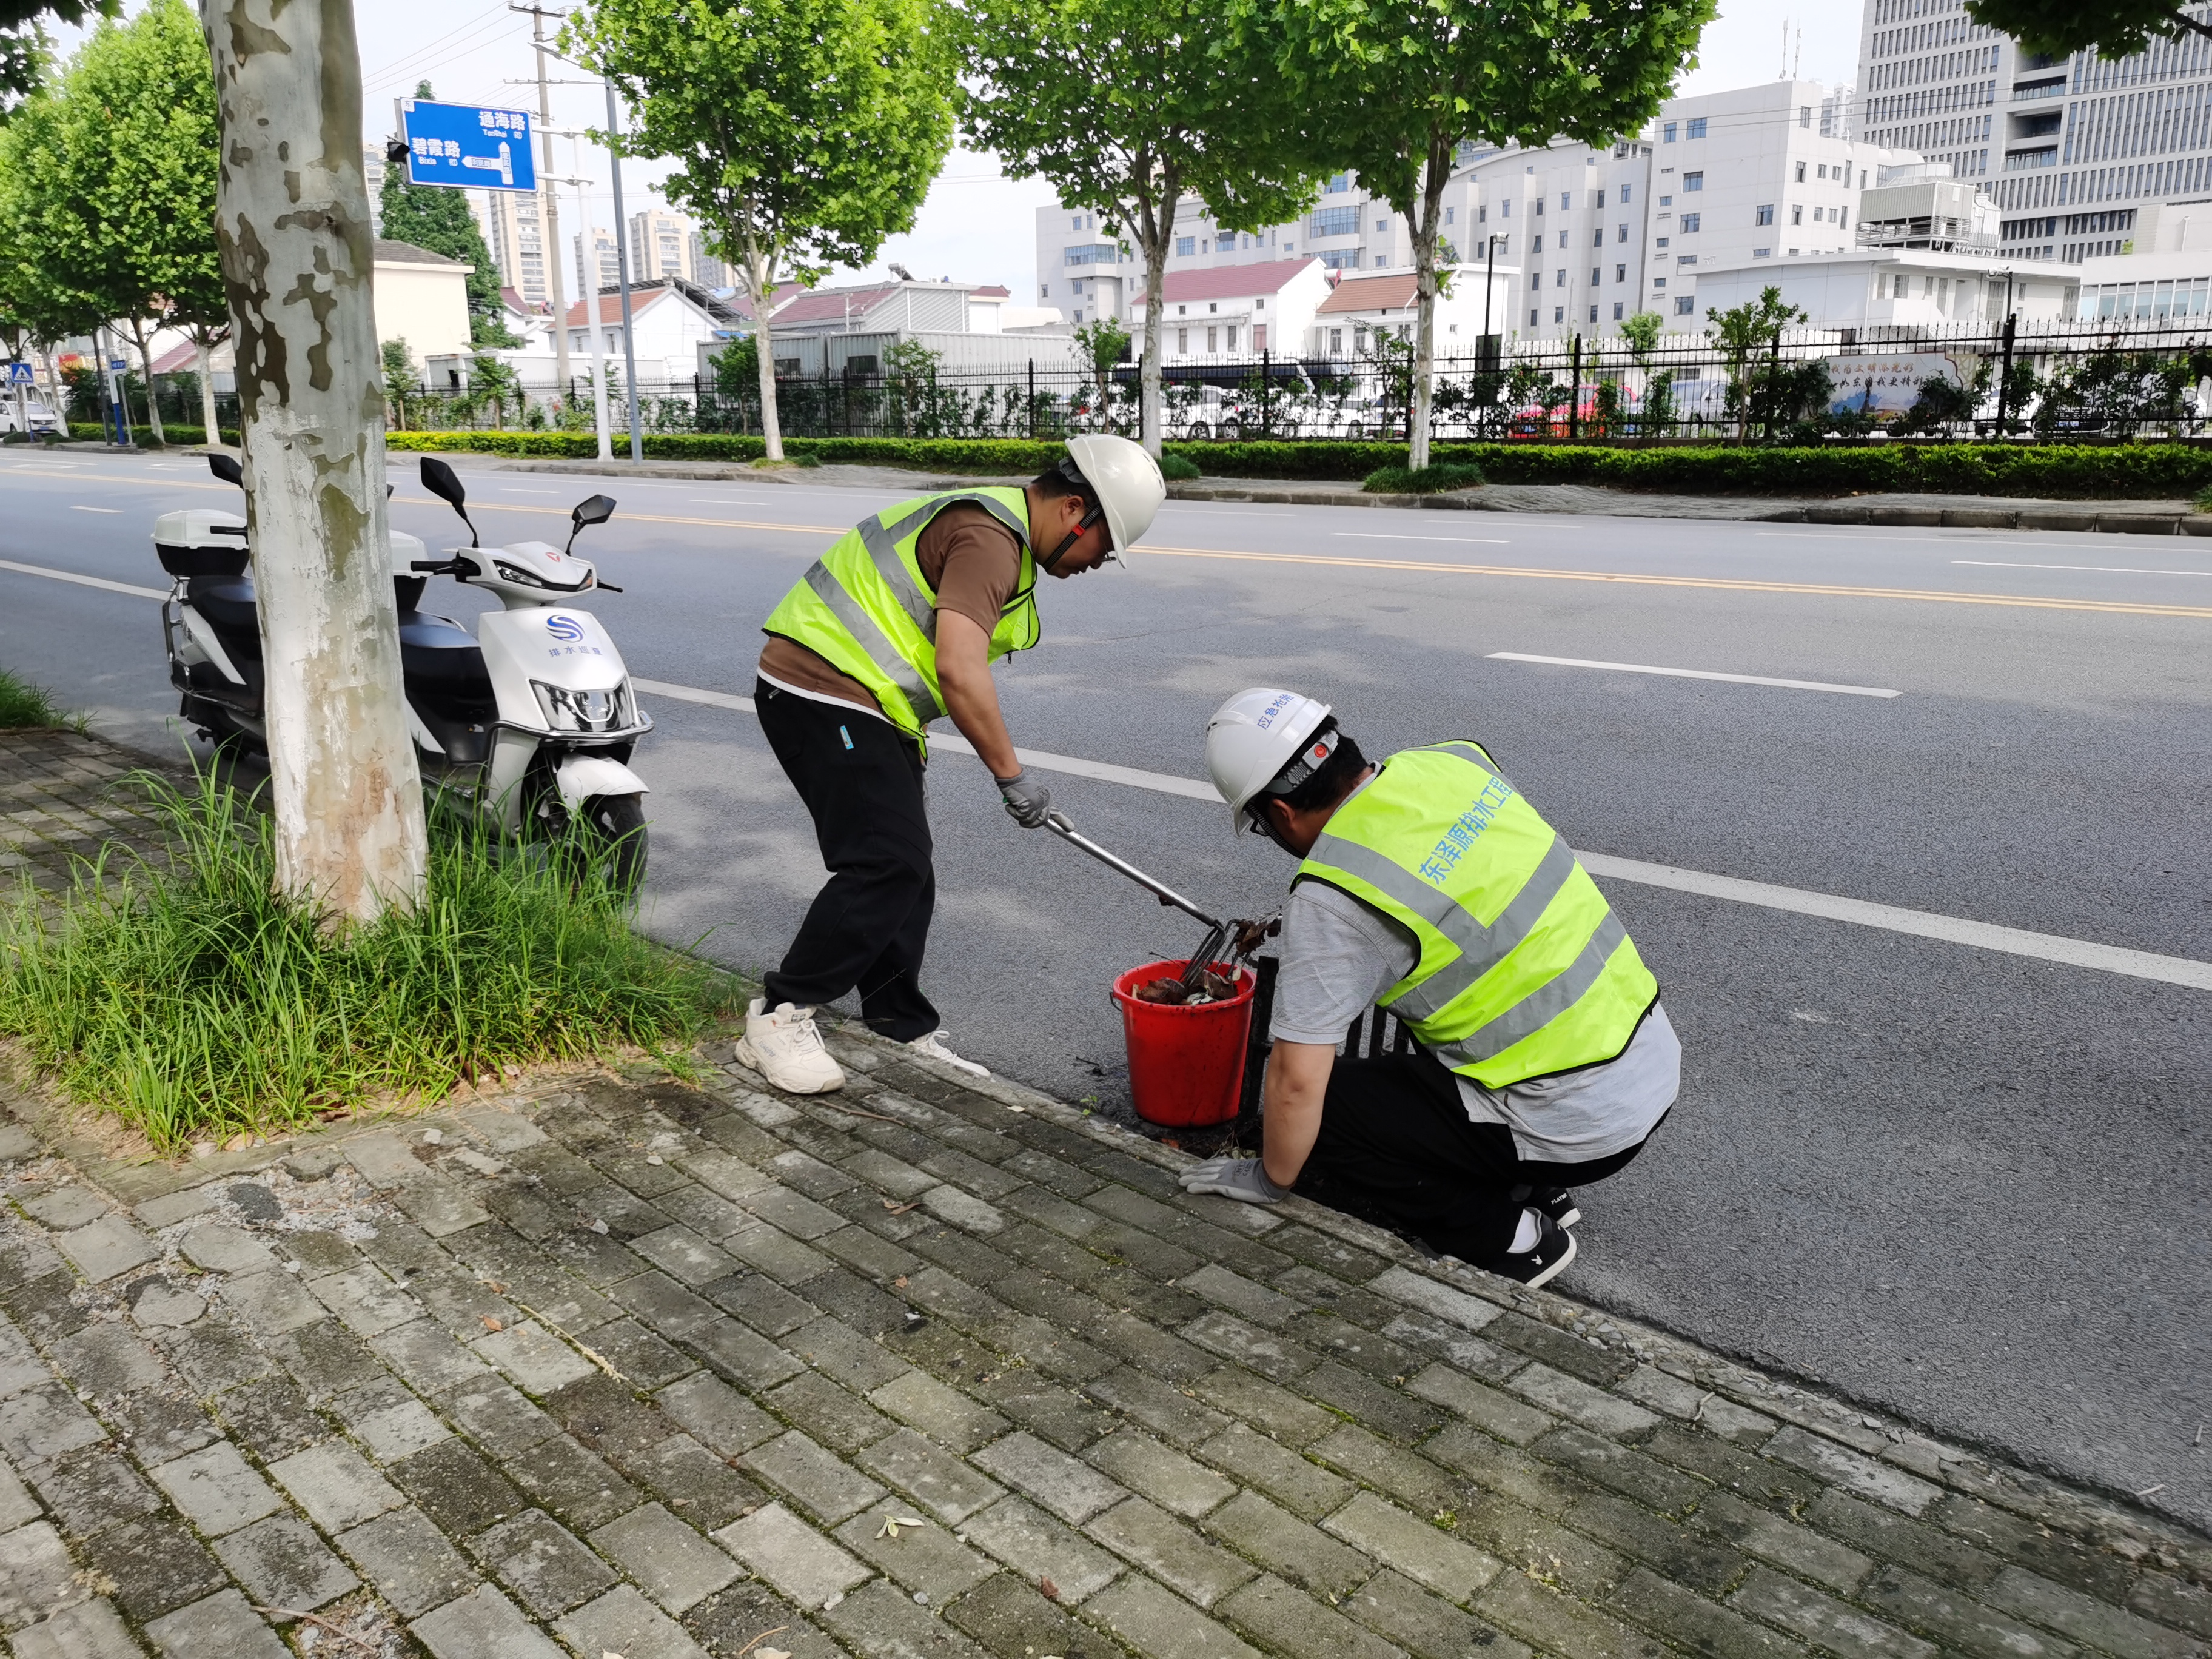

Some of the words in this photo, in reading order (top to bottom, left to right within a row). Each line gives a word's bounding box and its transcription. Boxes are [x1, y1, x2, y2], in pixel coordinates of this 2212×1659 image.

[478, 110, 526, 132] 通海路
[411, 137, 461, 158] 碧霞路
